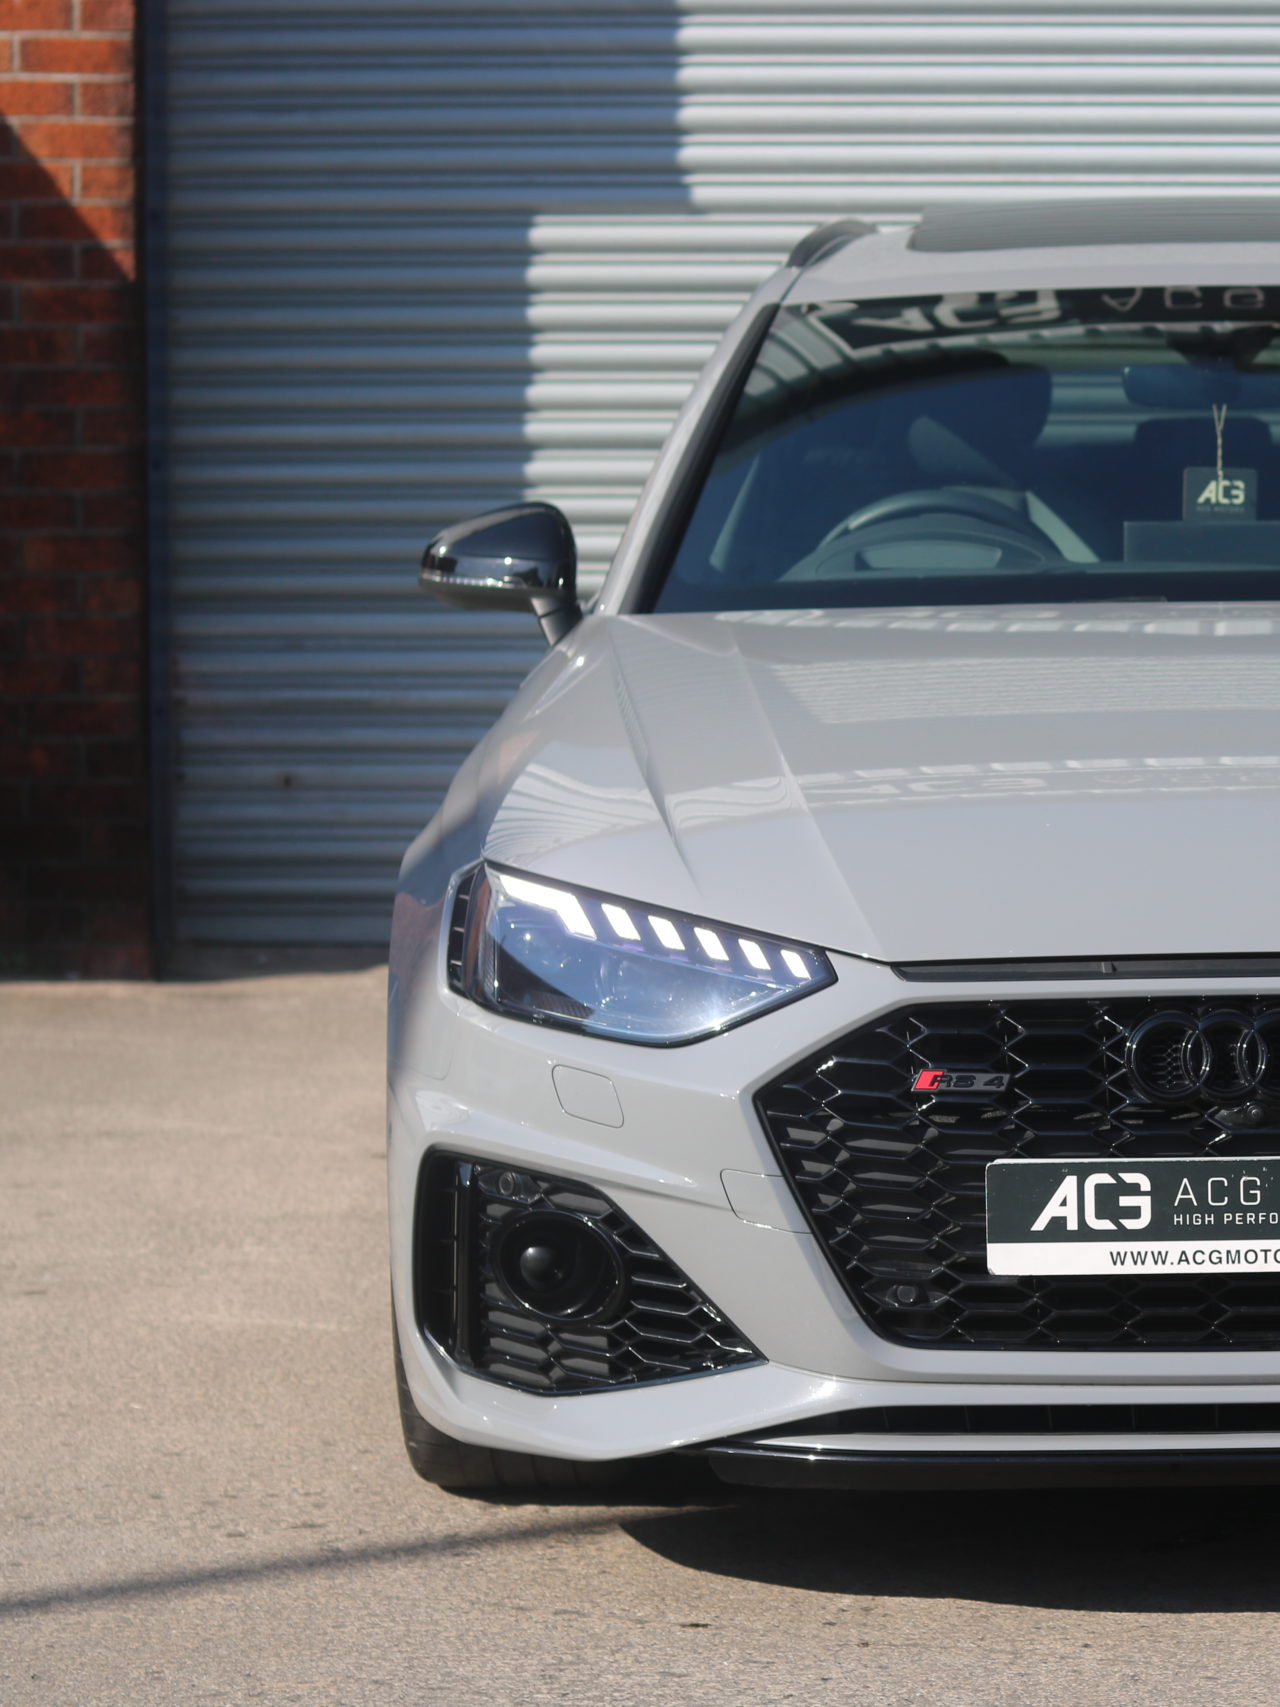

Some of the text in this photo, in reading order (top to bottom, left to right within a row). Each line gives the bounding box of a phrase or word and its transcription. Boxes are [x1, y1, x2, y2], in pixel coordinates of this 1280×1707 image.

[1197, 480, 1245, 504] ACG
[1030, 1172, 1152, 1231] ACG
[1174, 1176, 1261, 1206] ACG
[1174, 1213, 1215, 1225] HIGH
